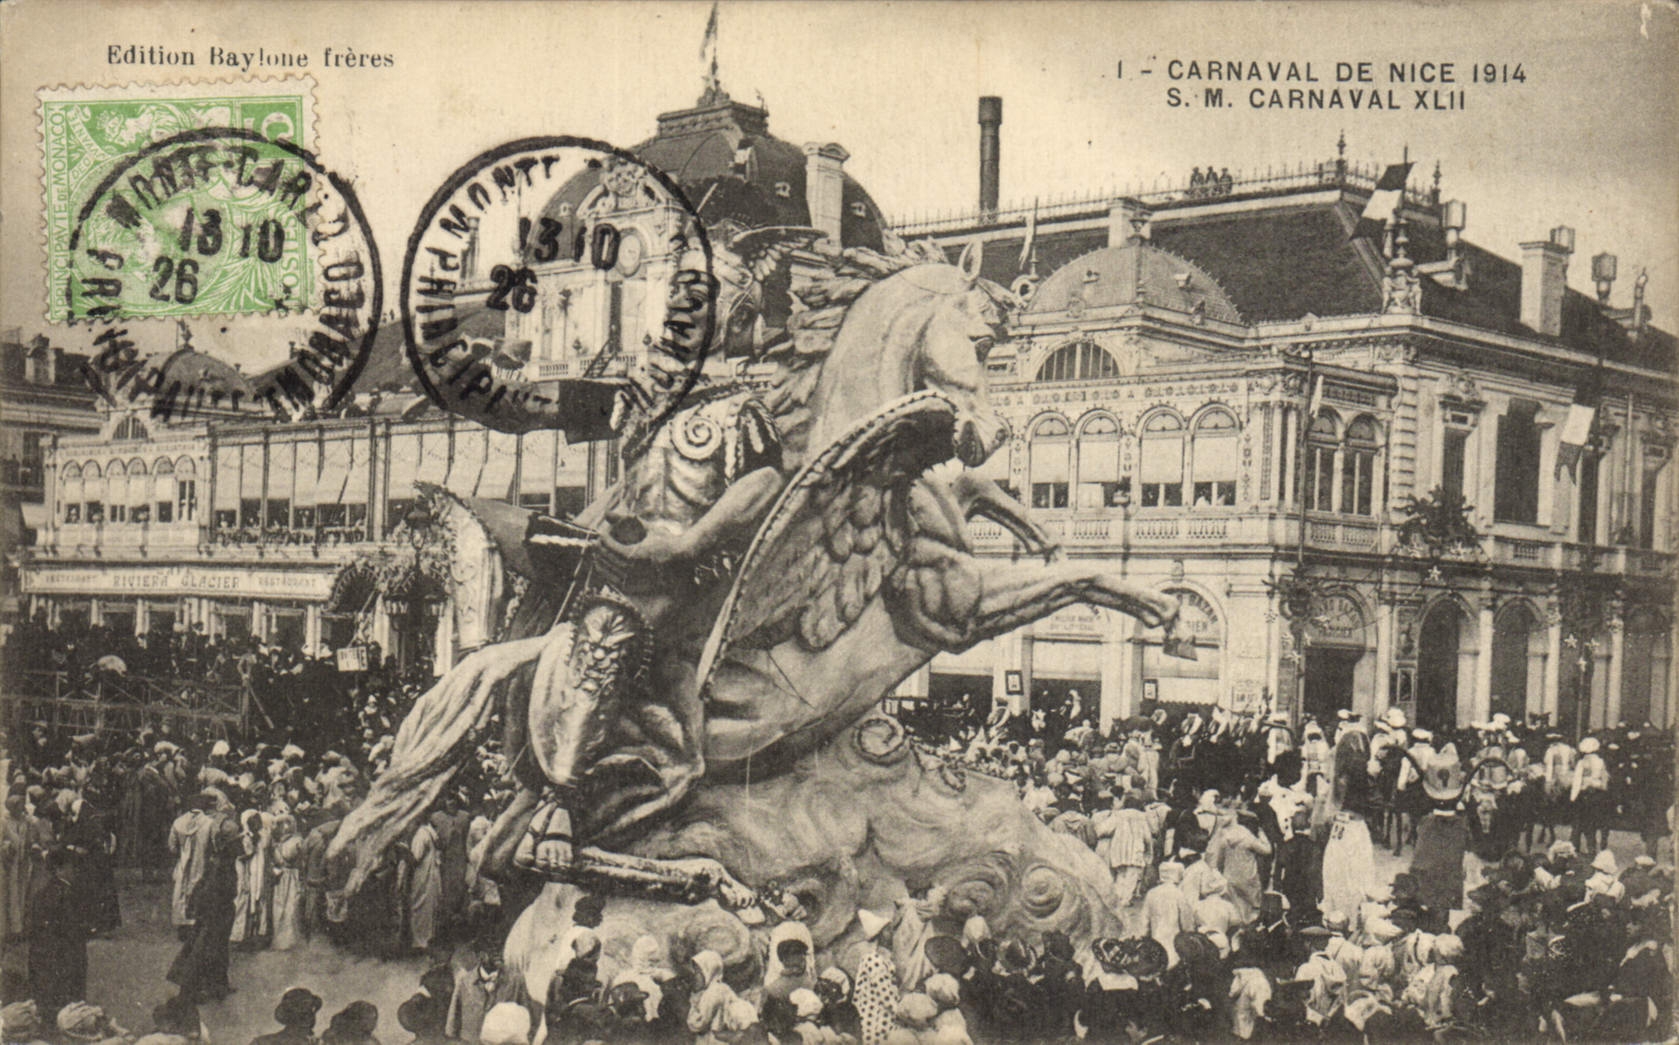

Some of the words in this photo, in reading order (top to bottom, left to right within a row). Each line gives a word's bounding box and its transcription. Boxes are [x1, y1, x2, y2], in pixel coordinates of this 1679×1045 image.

[50, 112, 68, 186] MONACO
[113, 575, 169, 588] RIVIERA
[181, 575, 240, 589] GLACIER
